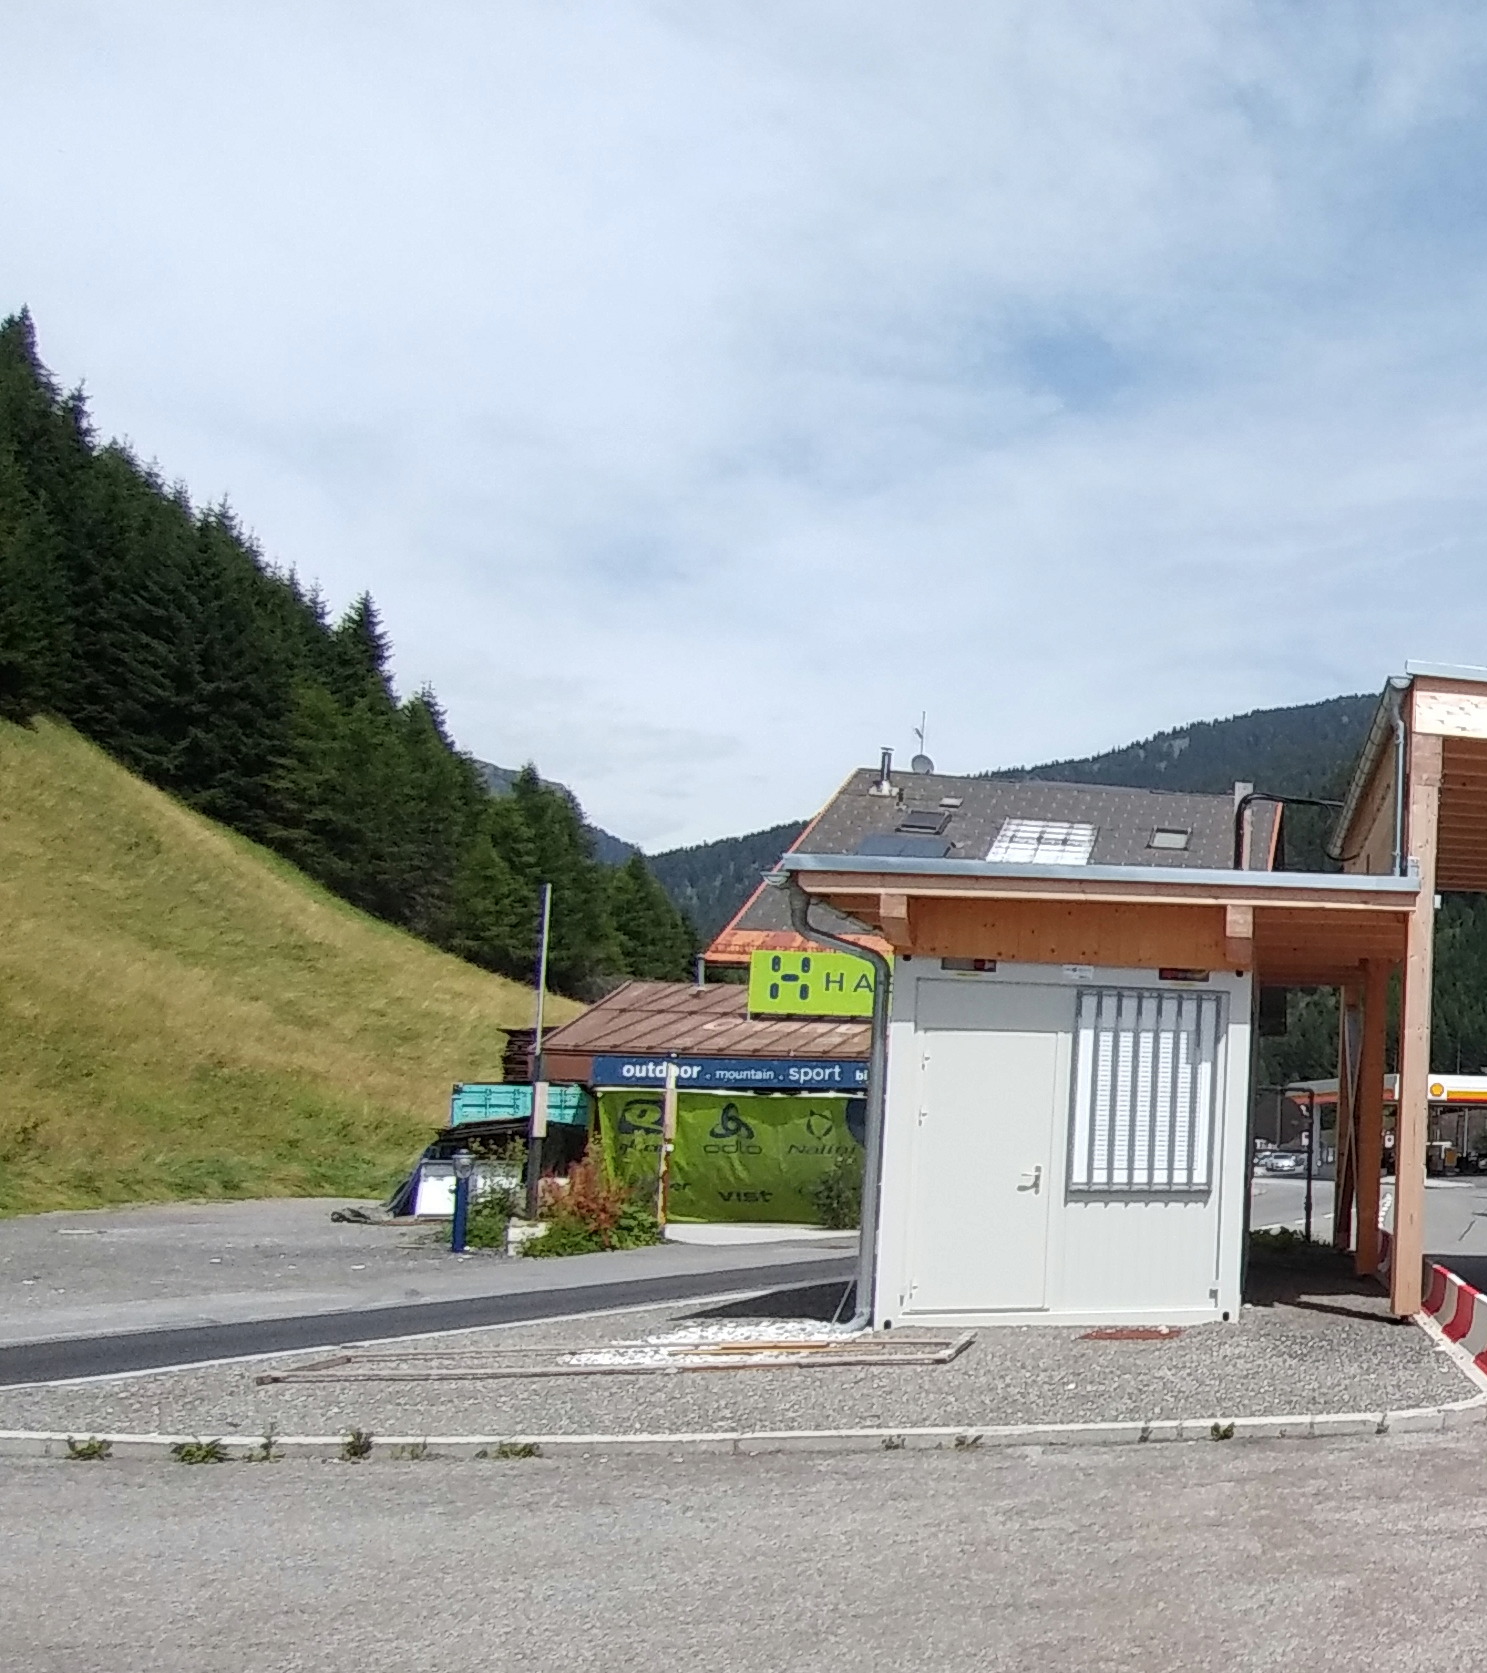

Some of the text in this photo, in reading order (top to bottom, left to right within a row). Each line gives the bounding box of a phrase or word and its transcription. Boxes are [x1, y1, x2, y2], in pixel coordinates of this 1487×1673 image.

[824, 971, 893, 993] HA
[621, 1061, 869, 1082] outdoor mountain sport bi
